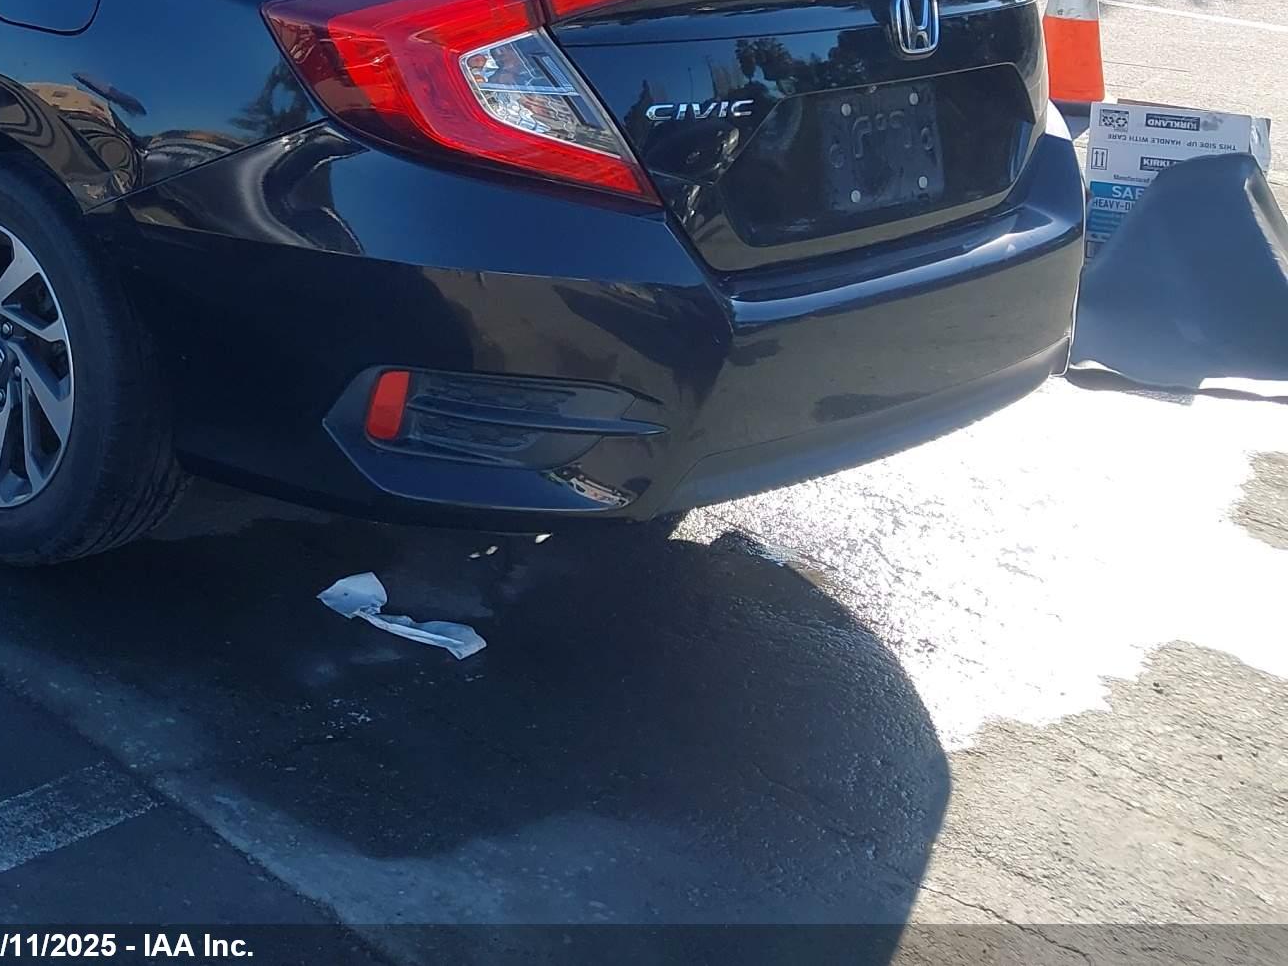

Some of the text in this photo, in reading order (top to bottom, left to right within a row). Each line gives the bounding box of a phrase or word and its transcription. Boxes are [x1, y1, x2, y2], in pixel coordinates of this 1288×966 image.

[646, 99, 754, 121] CIVIC
[1128, 135, 1149, 144] WITH
[1151, 137, 1182, 147] HANDLE
[1199, 141, 1217, 150] SIDE
[1218, 143, 1237, 151] THIS
